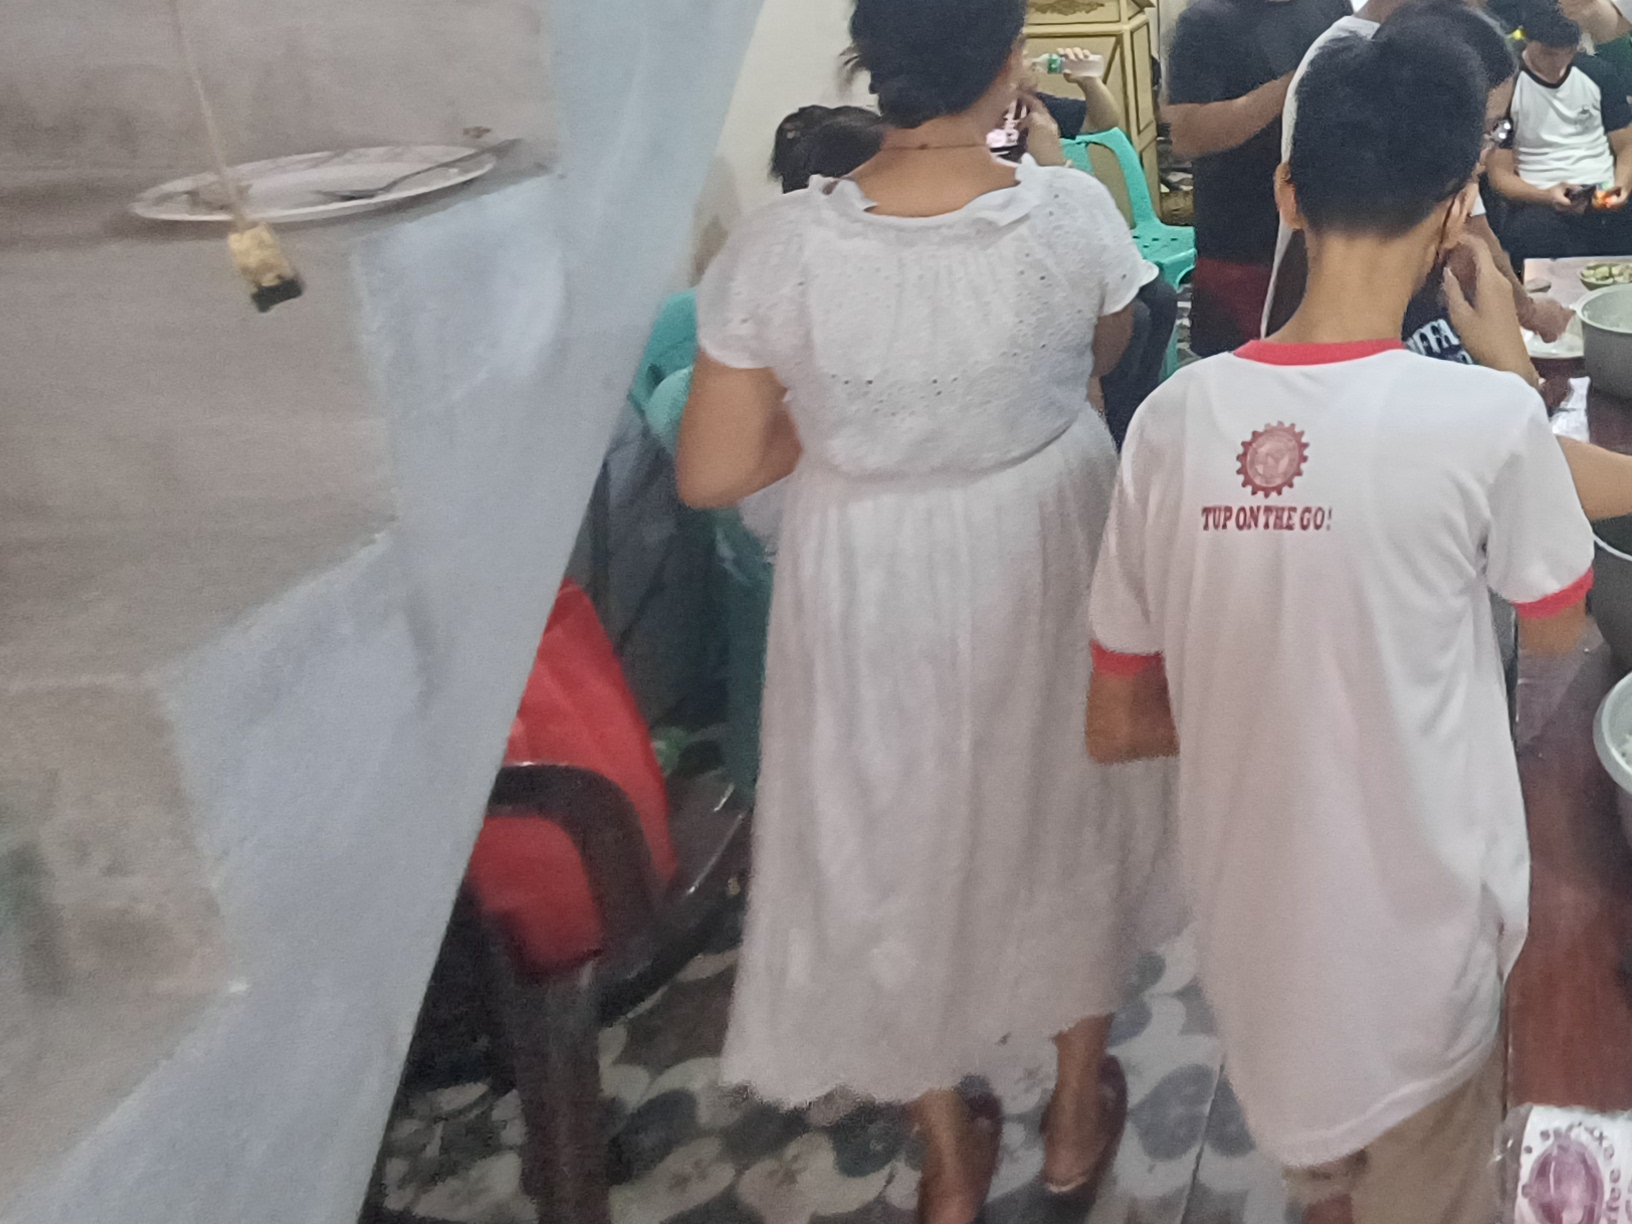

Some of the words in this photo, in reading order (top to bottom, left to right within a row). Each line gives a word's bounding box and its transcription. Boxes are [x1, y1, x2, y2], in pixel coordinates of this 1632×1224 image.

[1201, 505, 1233, 531] TUP
[1235, 505, 1261, 531] ON
[1263, 505, 1297, 531] THE
[1300, 506, 1332, 532] GO!
